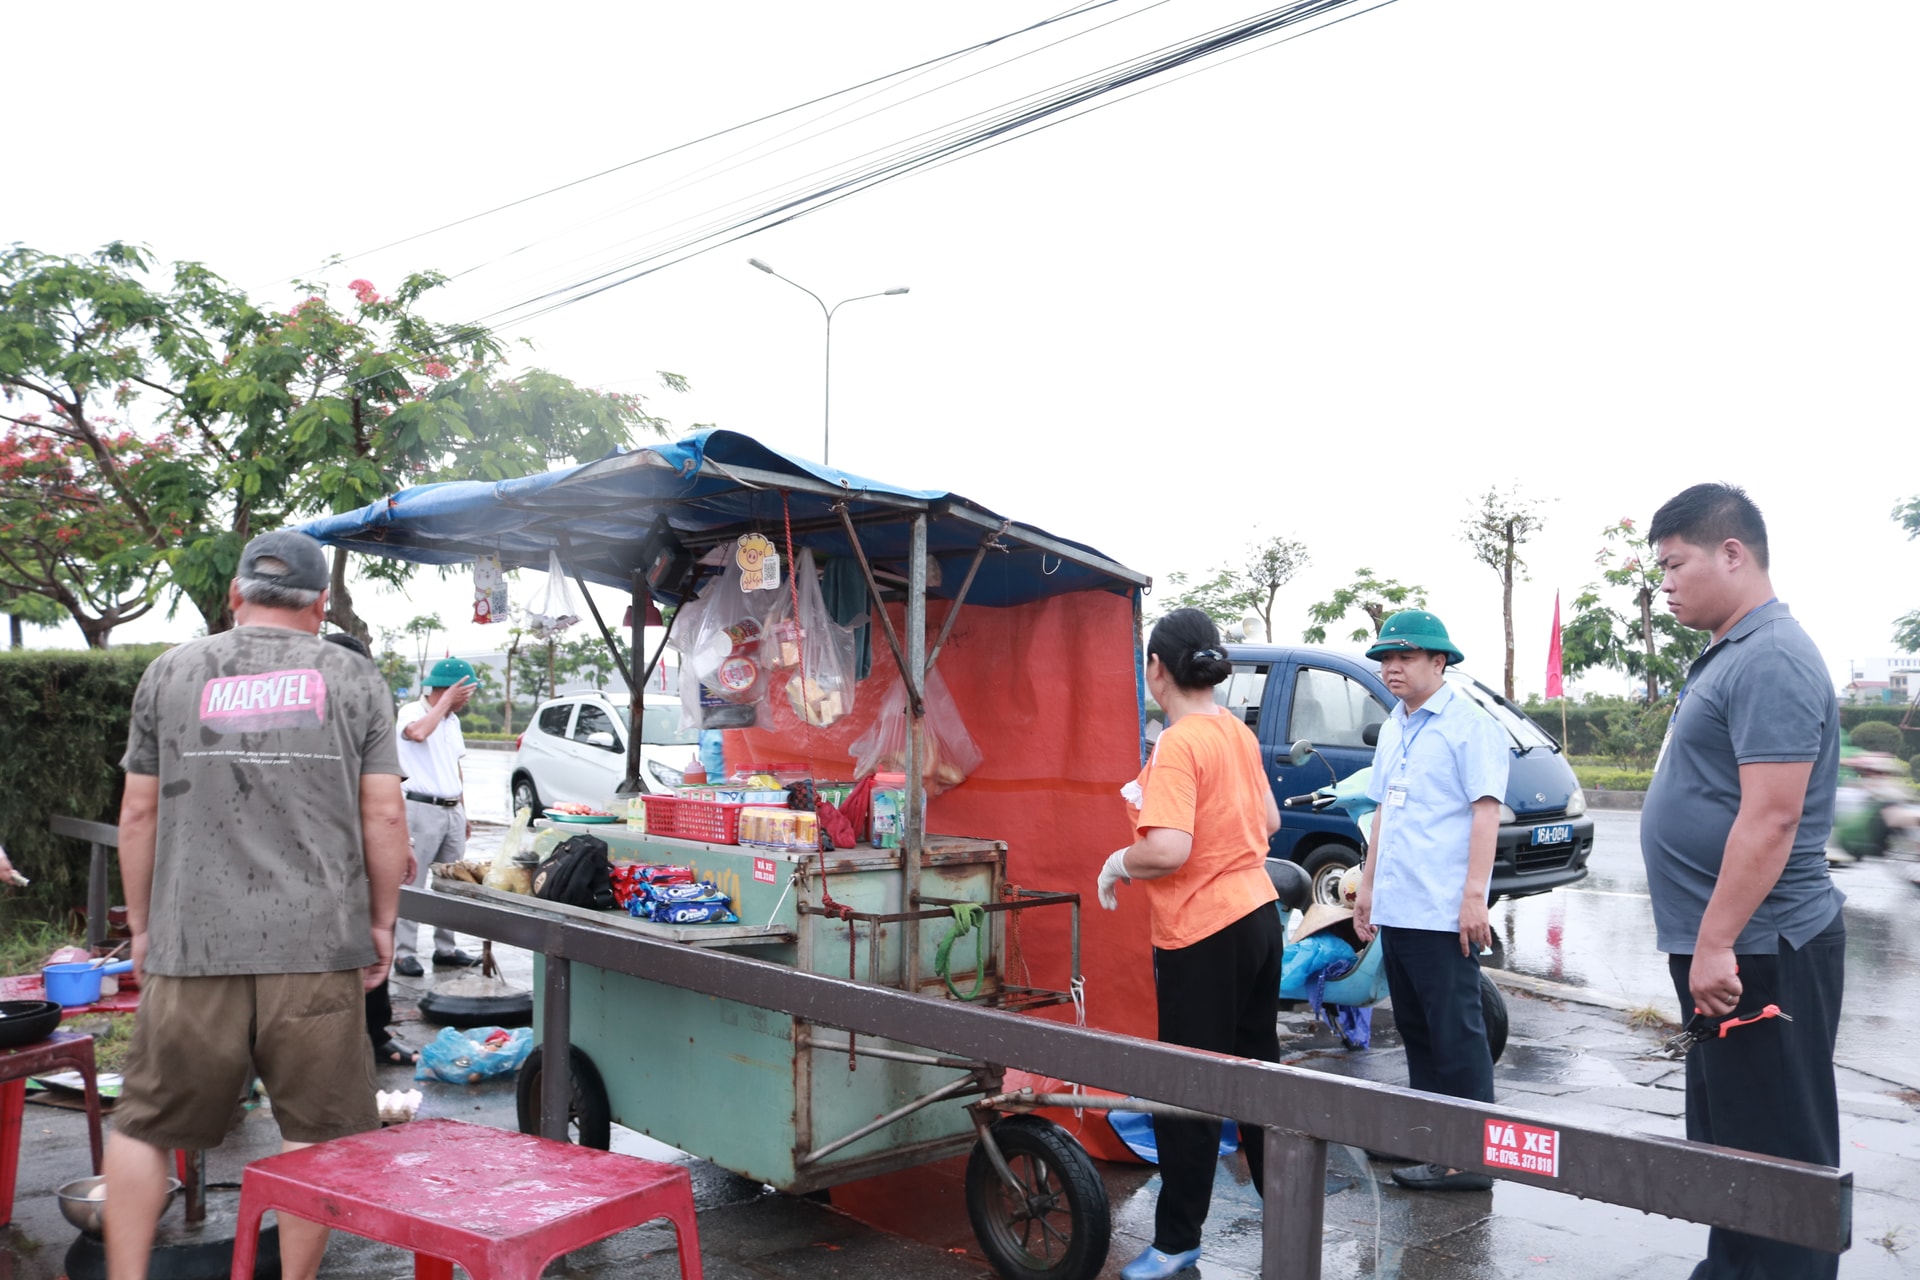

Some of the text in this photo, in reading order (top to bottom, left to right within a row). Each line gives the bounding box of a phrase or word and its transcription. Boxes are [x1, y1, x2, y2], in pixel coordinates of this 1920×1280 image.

[207, 675, 311, 713] MARVEL
[765, 862, 773, 872] XE
[1488, 1125, 1552, 1155] VÁ XE
[1521, 1153, 1536, 1170] 373
